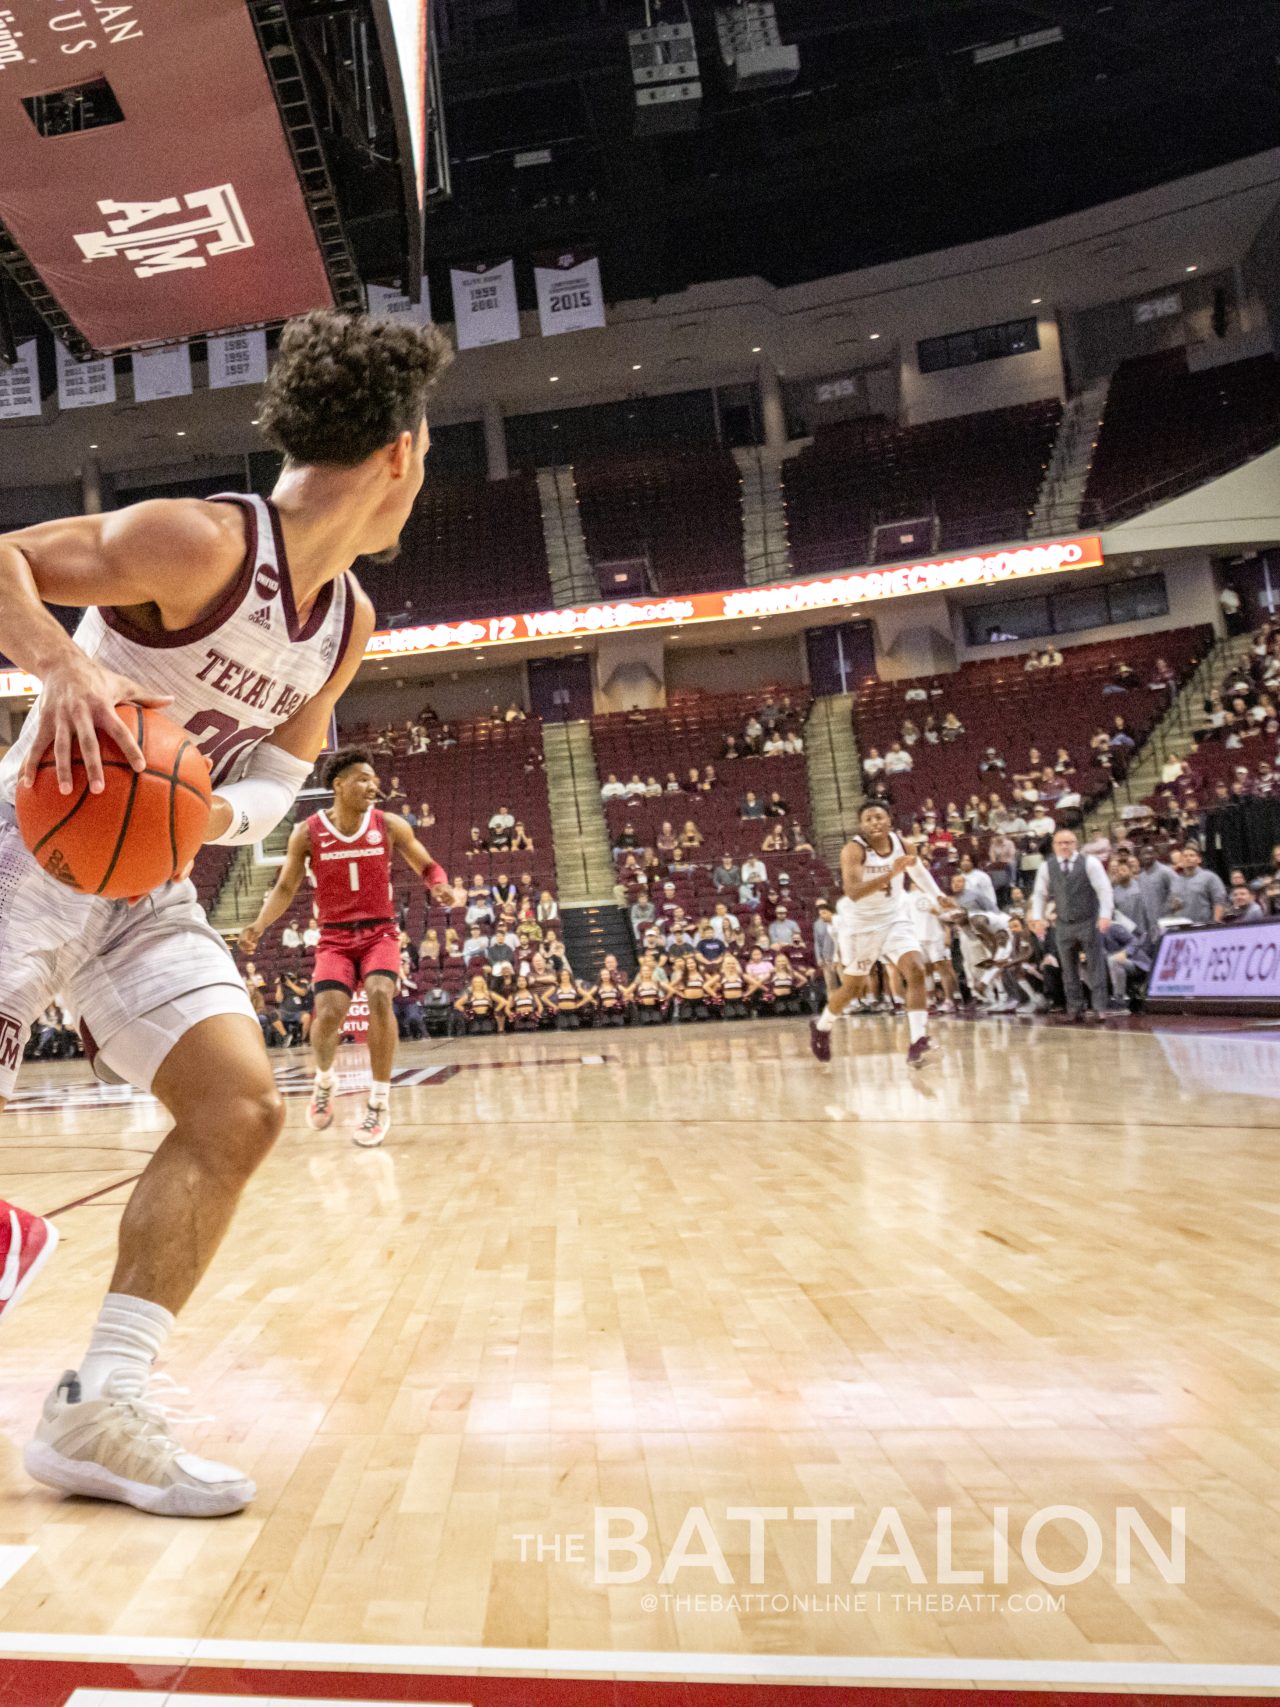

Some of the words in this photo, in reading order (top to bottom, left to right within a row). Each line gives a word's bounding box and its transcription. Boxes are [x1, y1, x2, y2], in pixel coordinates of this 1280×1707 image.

[550, 290, 592, 313] 2015
[248, 613, 272, 631] adidas
[488, 617, 517, 641] 12
[195, 648, 277, 711] TEXAS
[348, 862, 360, 892] 1
[1204, 945, 1246, 982] PEST
